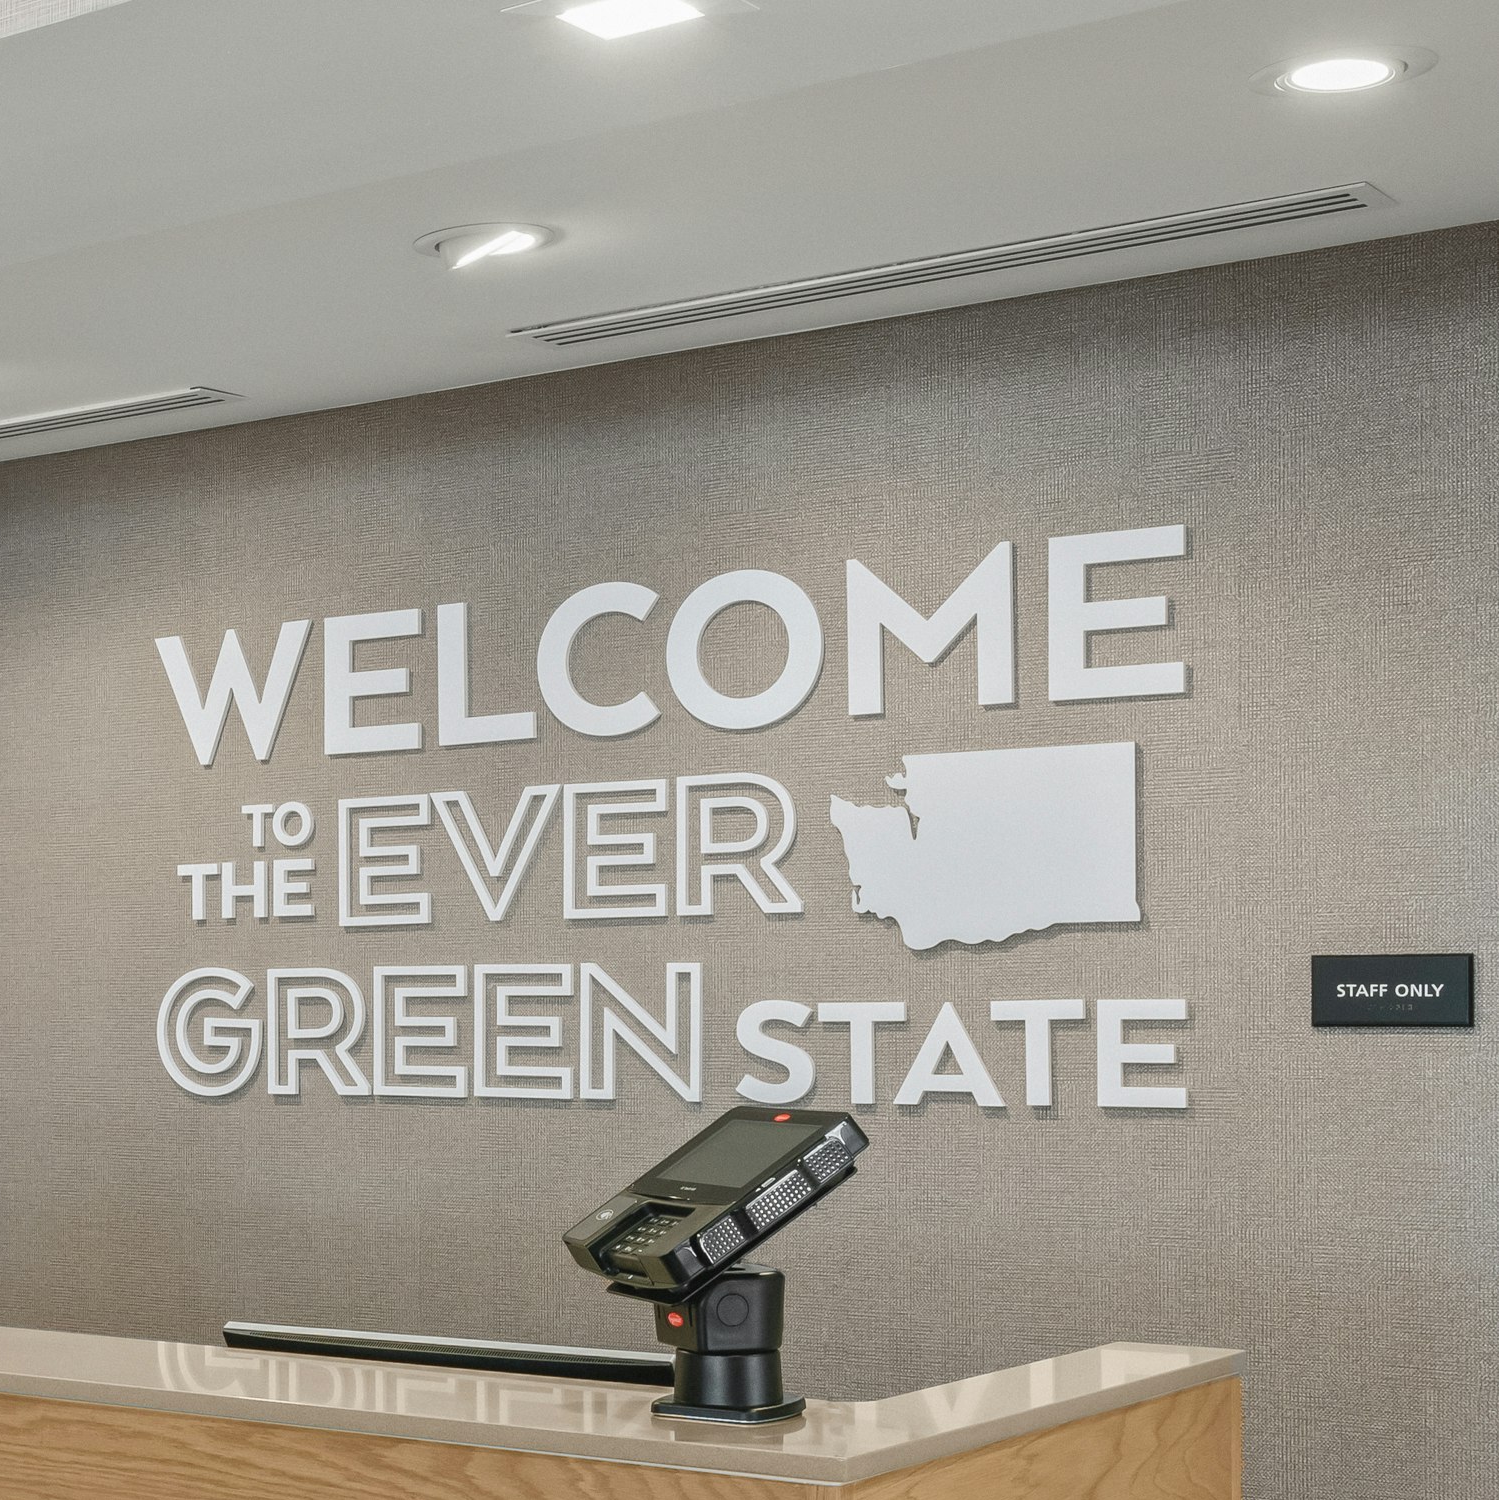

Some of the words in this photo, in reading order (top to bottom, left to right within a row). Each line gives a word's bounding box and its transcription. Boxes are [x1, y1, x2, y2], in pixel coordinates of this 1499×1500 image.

[155, 523, 1189, 767] WELCOME
[241, 801, 314, 848] TO
[337, 773, 805, 928] EVER
[177, 859, 316, 922] THE
[155, 962, 703, 1103] GREEN
[1336, 983, 1389, 998] STAFF
[1394, 983, 1445, 998] ONLY
[734, 998, 1190, 1110] STATE
